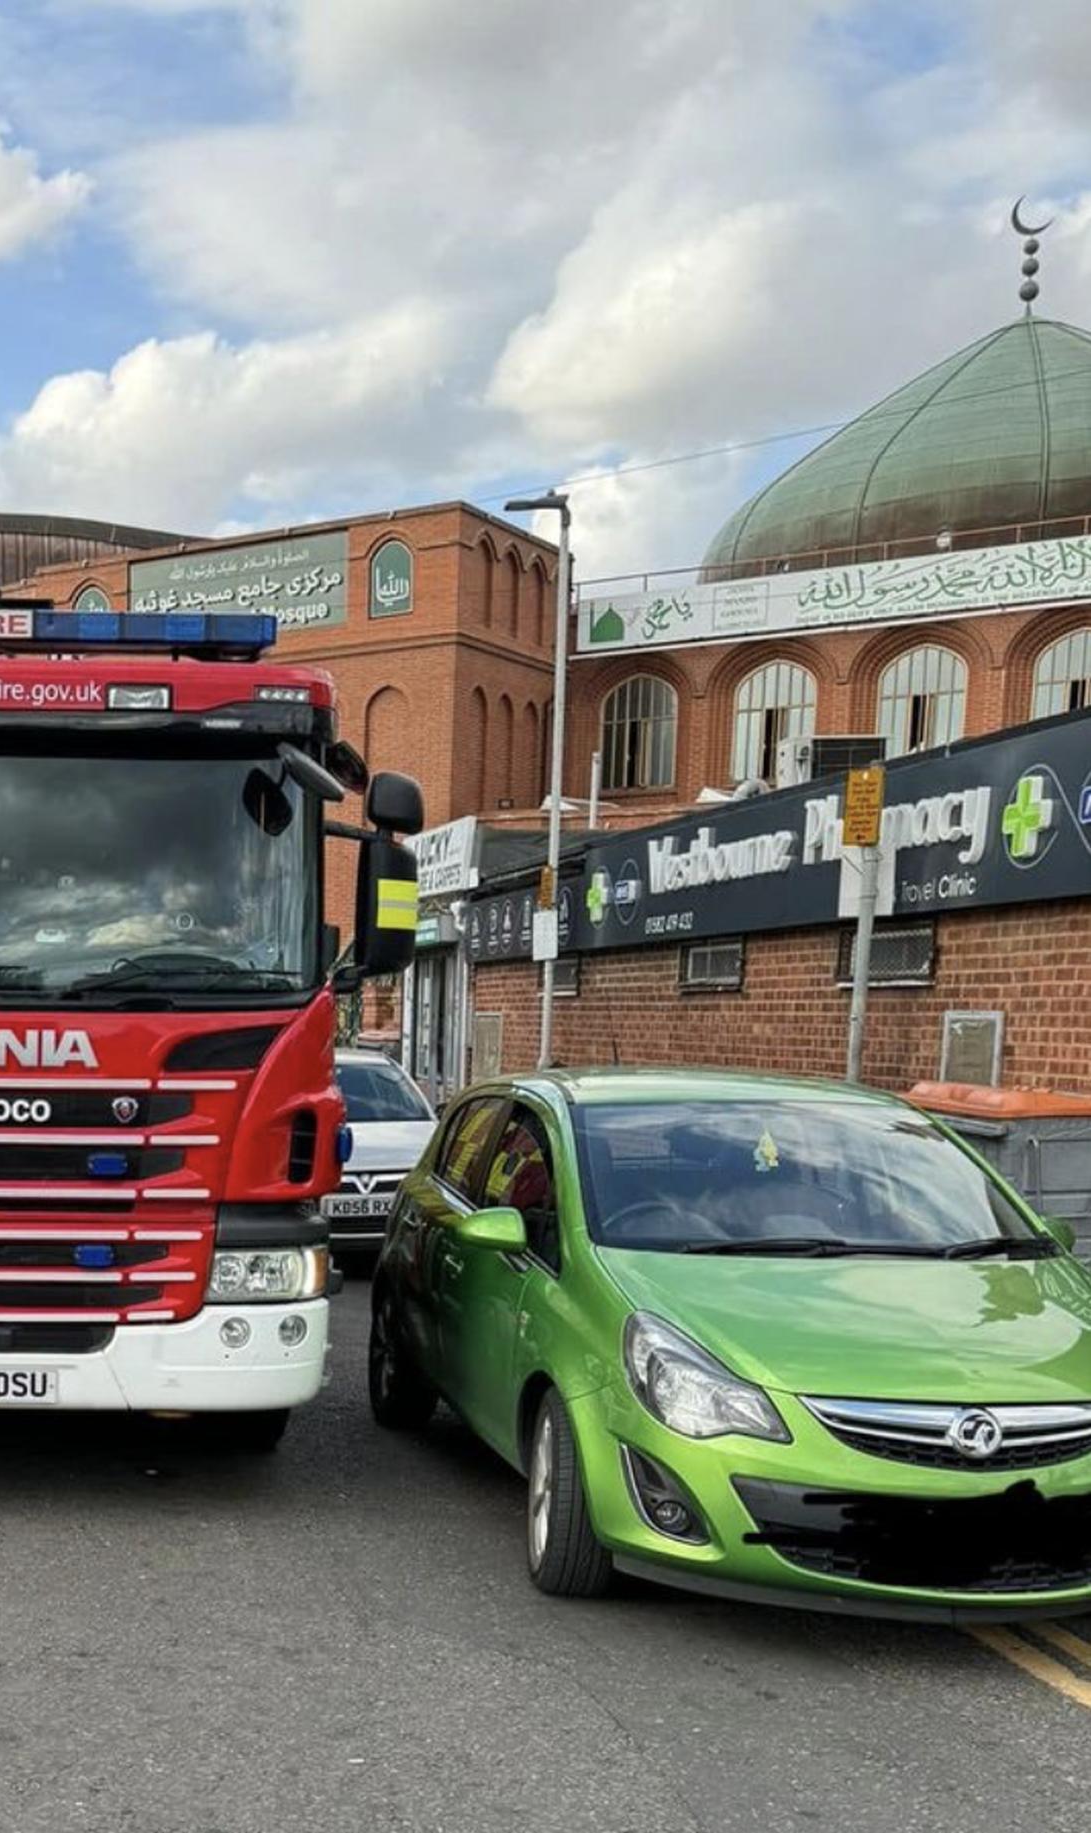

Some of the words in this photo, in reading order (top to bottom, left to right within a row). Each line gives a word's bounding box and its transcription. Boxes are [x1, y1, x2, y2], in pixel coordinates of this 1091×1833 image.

[647, 826, 798, 894] Westbourne
[803, 785, 991, 865] Phmacy
[938, 872, 977, 899] Clinic
